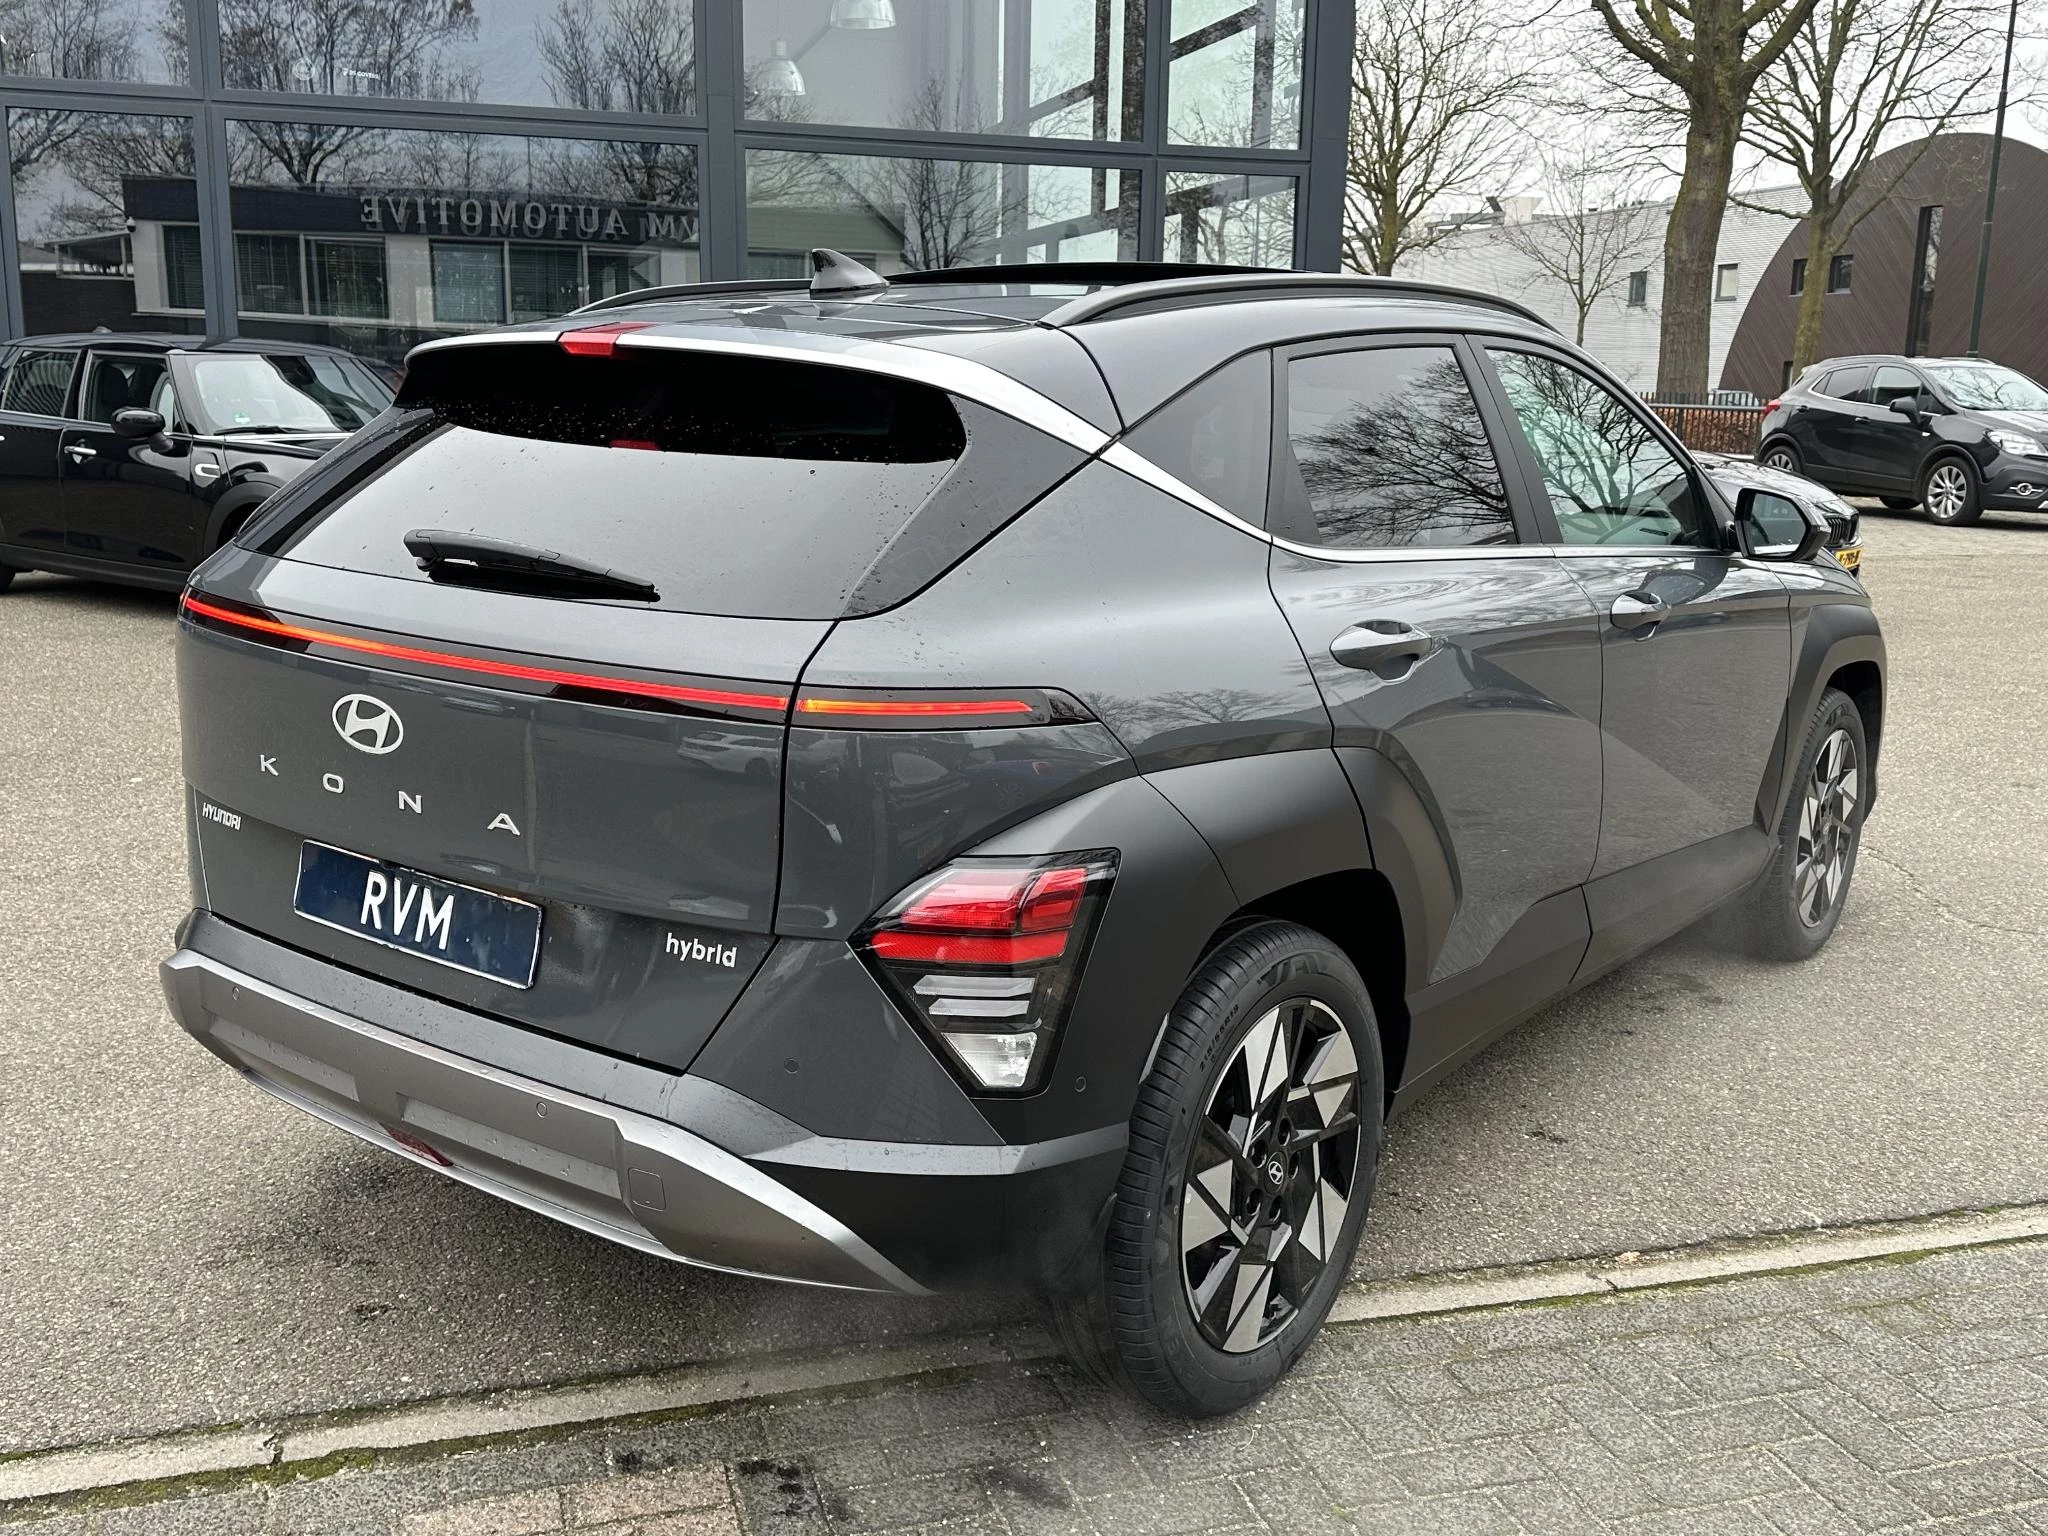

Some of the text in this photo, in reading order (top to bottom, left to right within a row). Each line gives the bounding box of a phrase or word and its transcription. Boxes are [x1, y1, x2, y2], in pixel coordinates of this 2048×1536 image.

[202, 802, 242, 830] HYUNDAI
[260, 755, 521, 836] KONA
[360, 871, 455, 950] RVM
[665, 932, 738, 968] hybrid
